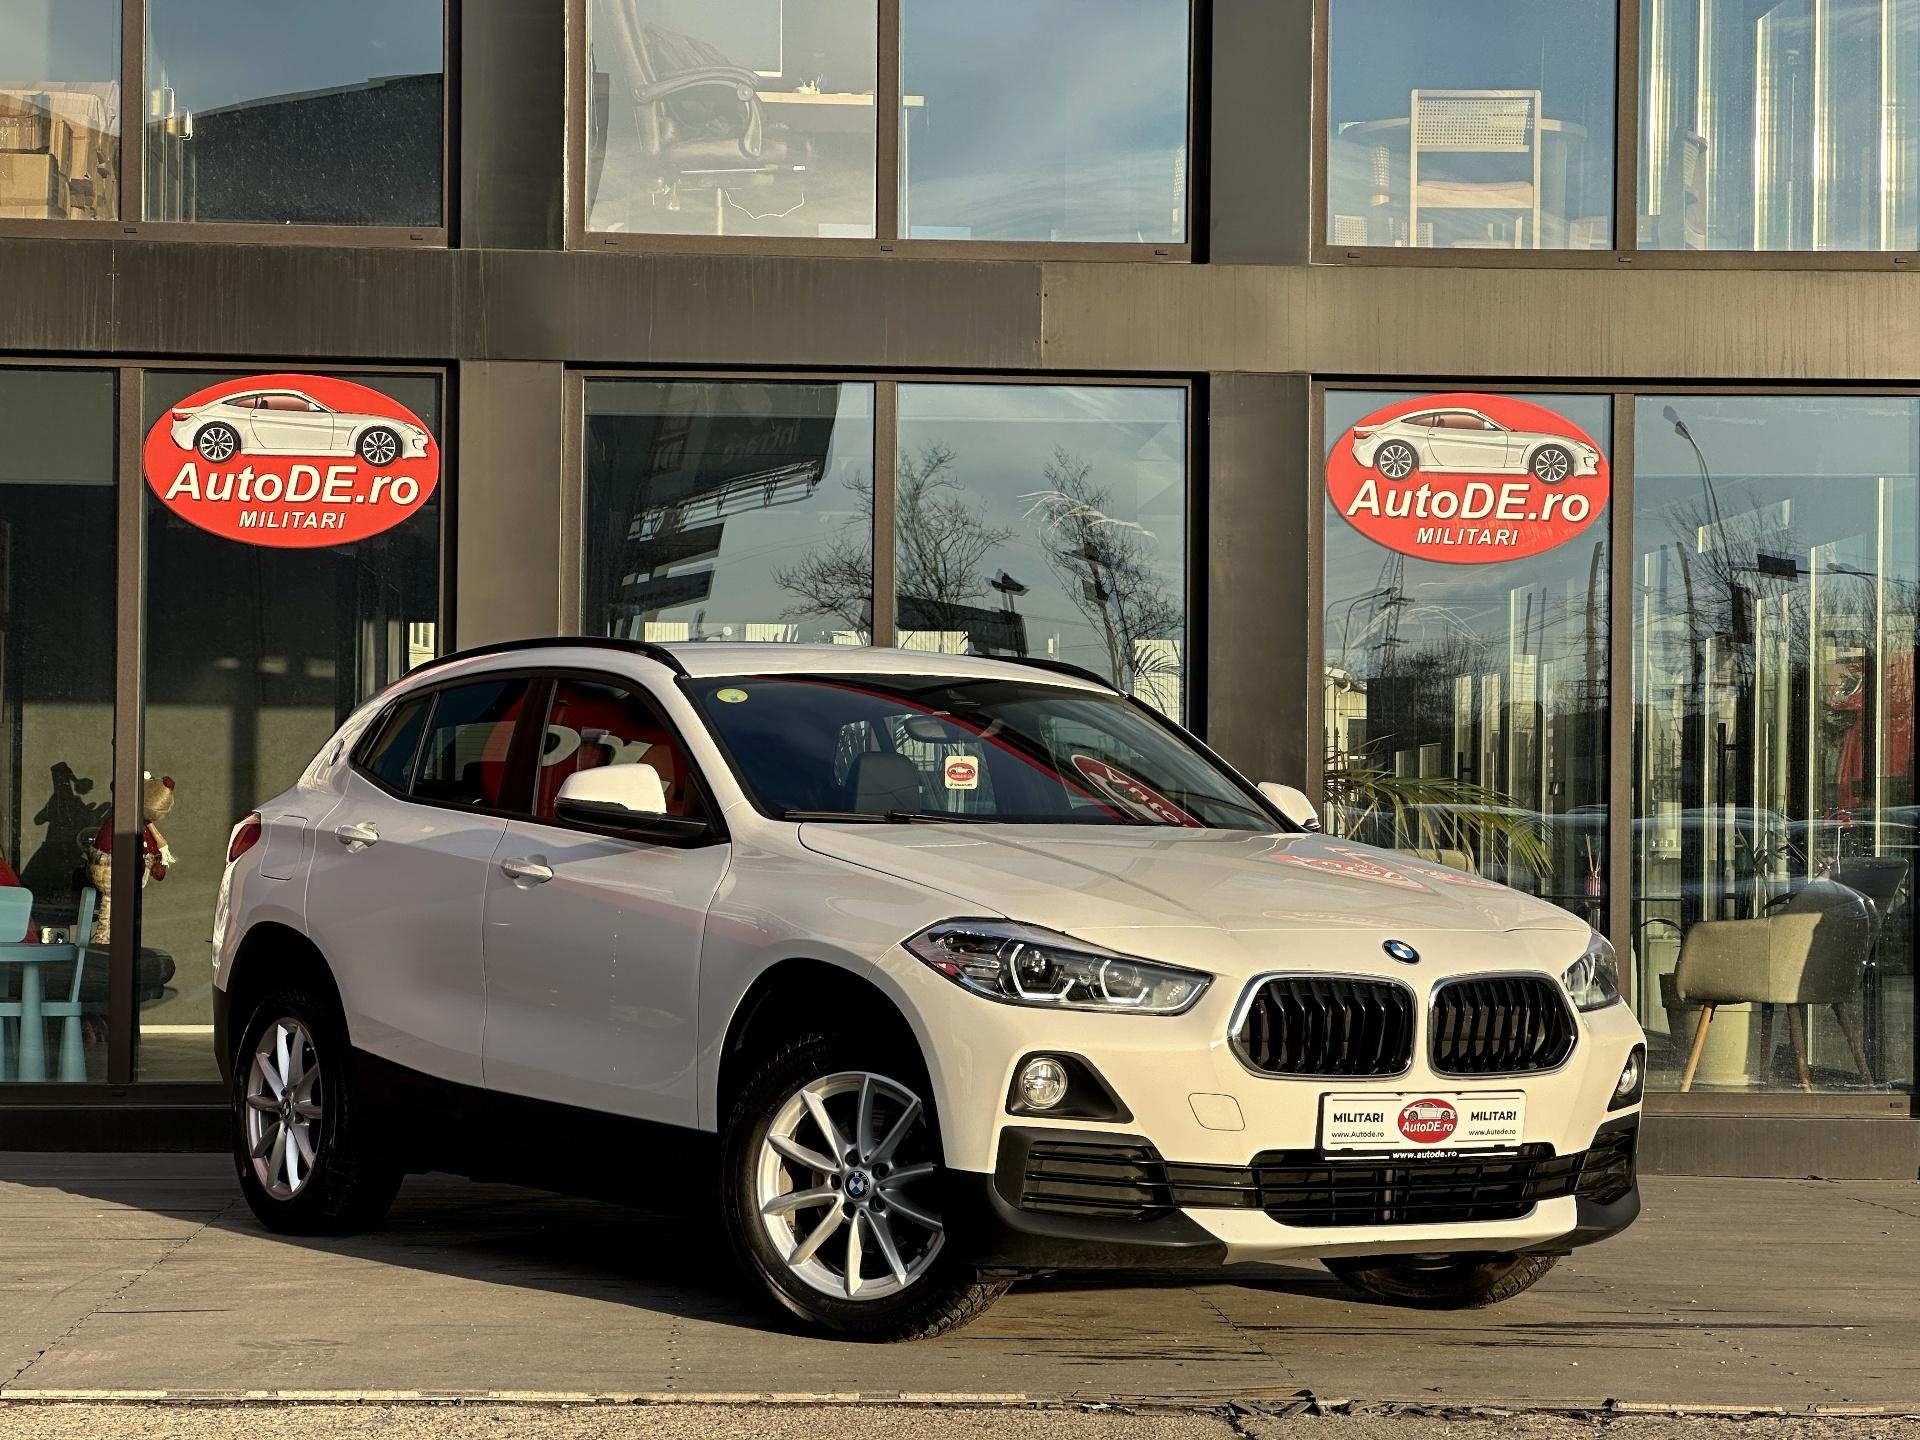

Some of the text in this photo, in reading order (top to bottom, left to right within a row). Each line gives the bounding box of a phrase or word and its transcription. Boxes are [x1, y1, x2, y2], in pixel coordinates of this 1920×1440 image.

[166, 462, 420, 505] AutoDE.ro
[1347, 479, 1591, 523] AutoDE.ro
[239, 510, 346, 530] MILITARI
[1416, 527, 1519, 547] MILITARI
[1333, 1112, 1384, 1123] MILITARI
[1470, 1111, 1517, 1121] MILITARI
[1402, 1121, 1454, 1133] AutoDE.ro
[1468, 1128, 1517, 1136] www.Autode.ro
[1392, 1149, 1458, 1159] www.autode.ro
